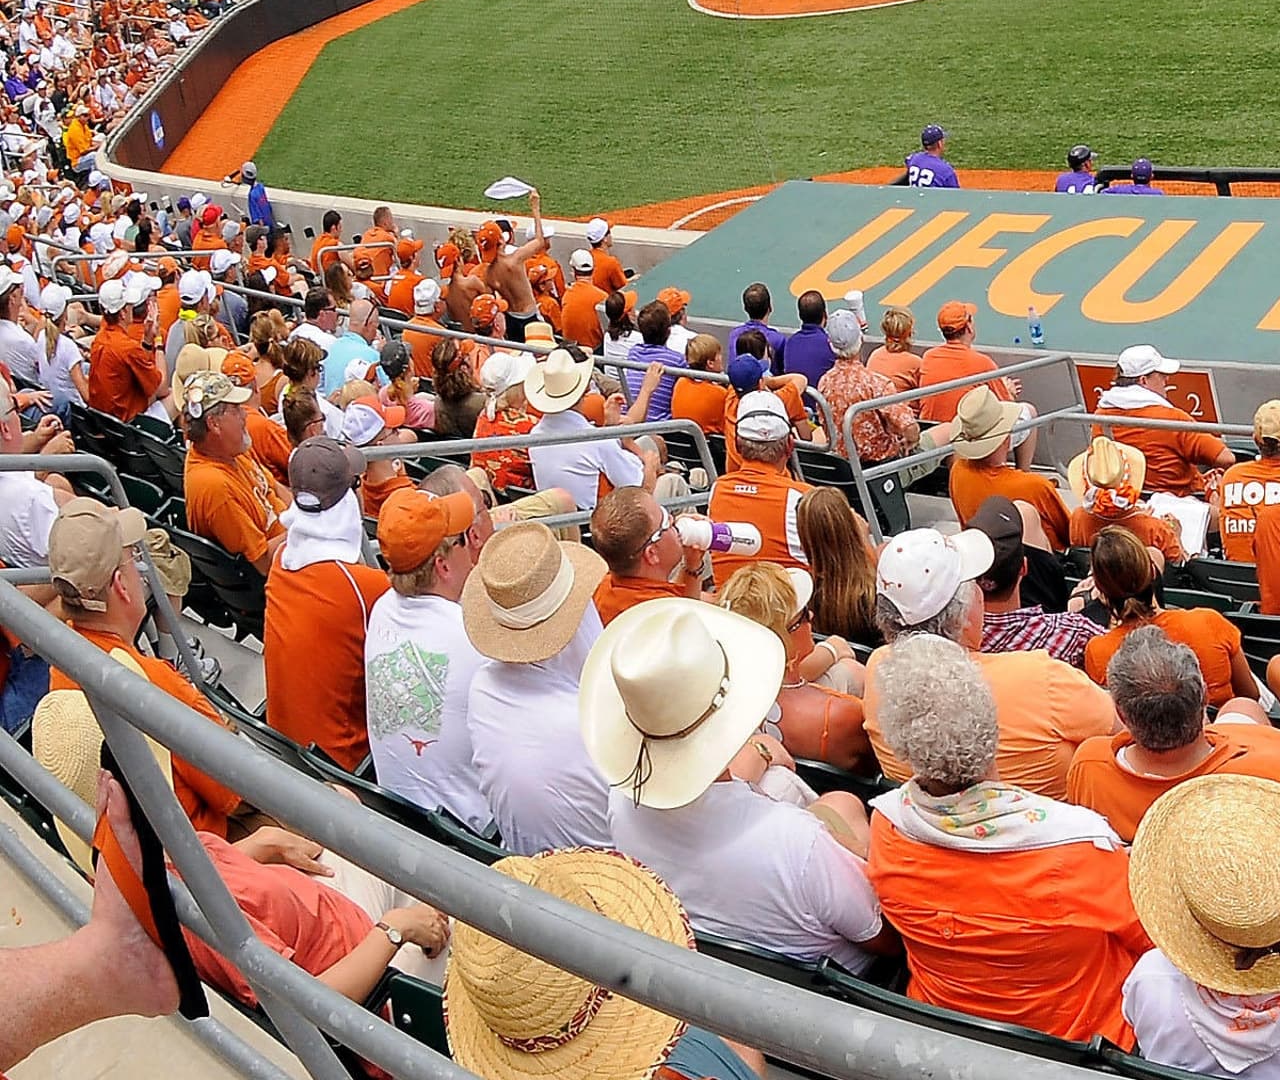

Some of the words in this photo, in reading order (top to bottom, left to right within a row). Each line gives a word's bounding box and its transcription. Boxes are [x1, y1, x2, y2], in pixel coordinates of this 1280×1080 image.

[908, 167, 935, 188] 22
[790, 208, 1265, 322] UFCU
[1186, 393, 1204, 417] 2
